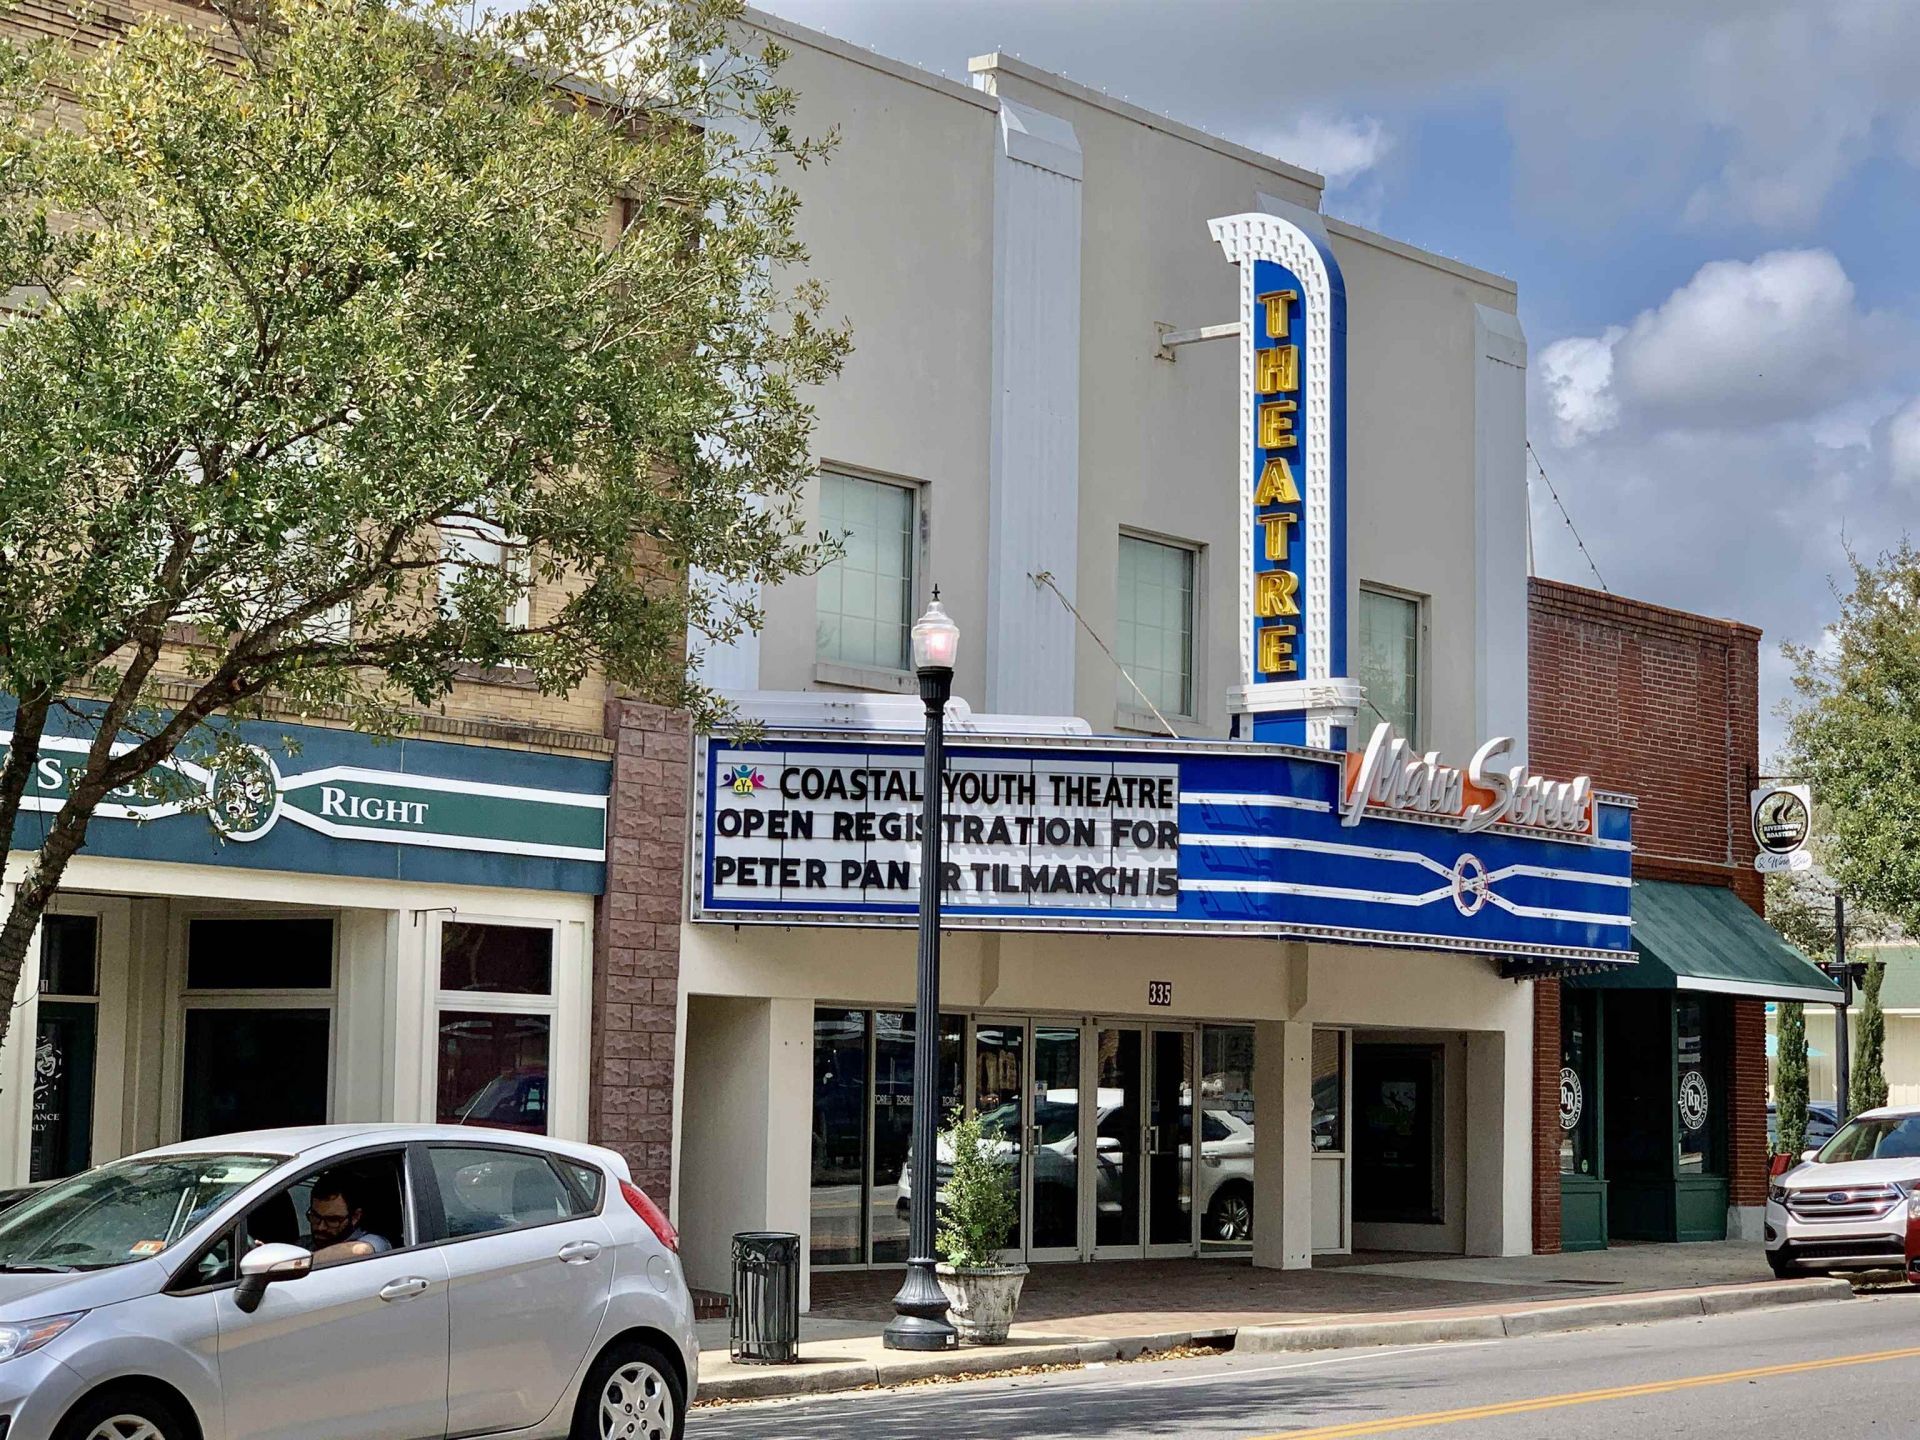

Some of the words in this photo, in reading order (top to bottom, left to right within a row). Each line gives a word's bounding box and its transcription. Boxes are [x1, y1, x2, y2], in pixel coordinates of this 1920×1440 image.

[1253, 289, 1302, 673] THEATRE
[780, 767, 924, 801] COASTAL
[942, 773, 1036, 806] YOUTH
[1049, 775, 1173, 809] THEATRE
[1341, 722, 1464, 827] Main
[1458, 736, 1591, 833] Street
[717, 808, 813, 840] OPEN
[1112, 818, 1178, 850] FOR
[715, 856, 827, 888] PETER
[841, 859, 910, 890] PAN
[1150, 983, 1171, 1004] 335
[1561, 1086, 1574, 1110] RR
[1688, 1089, 1701, 1111] RR
